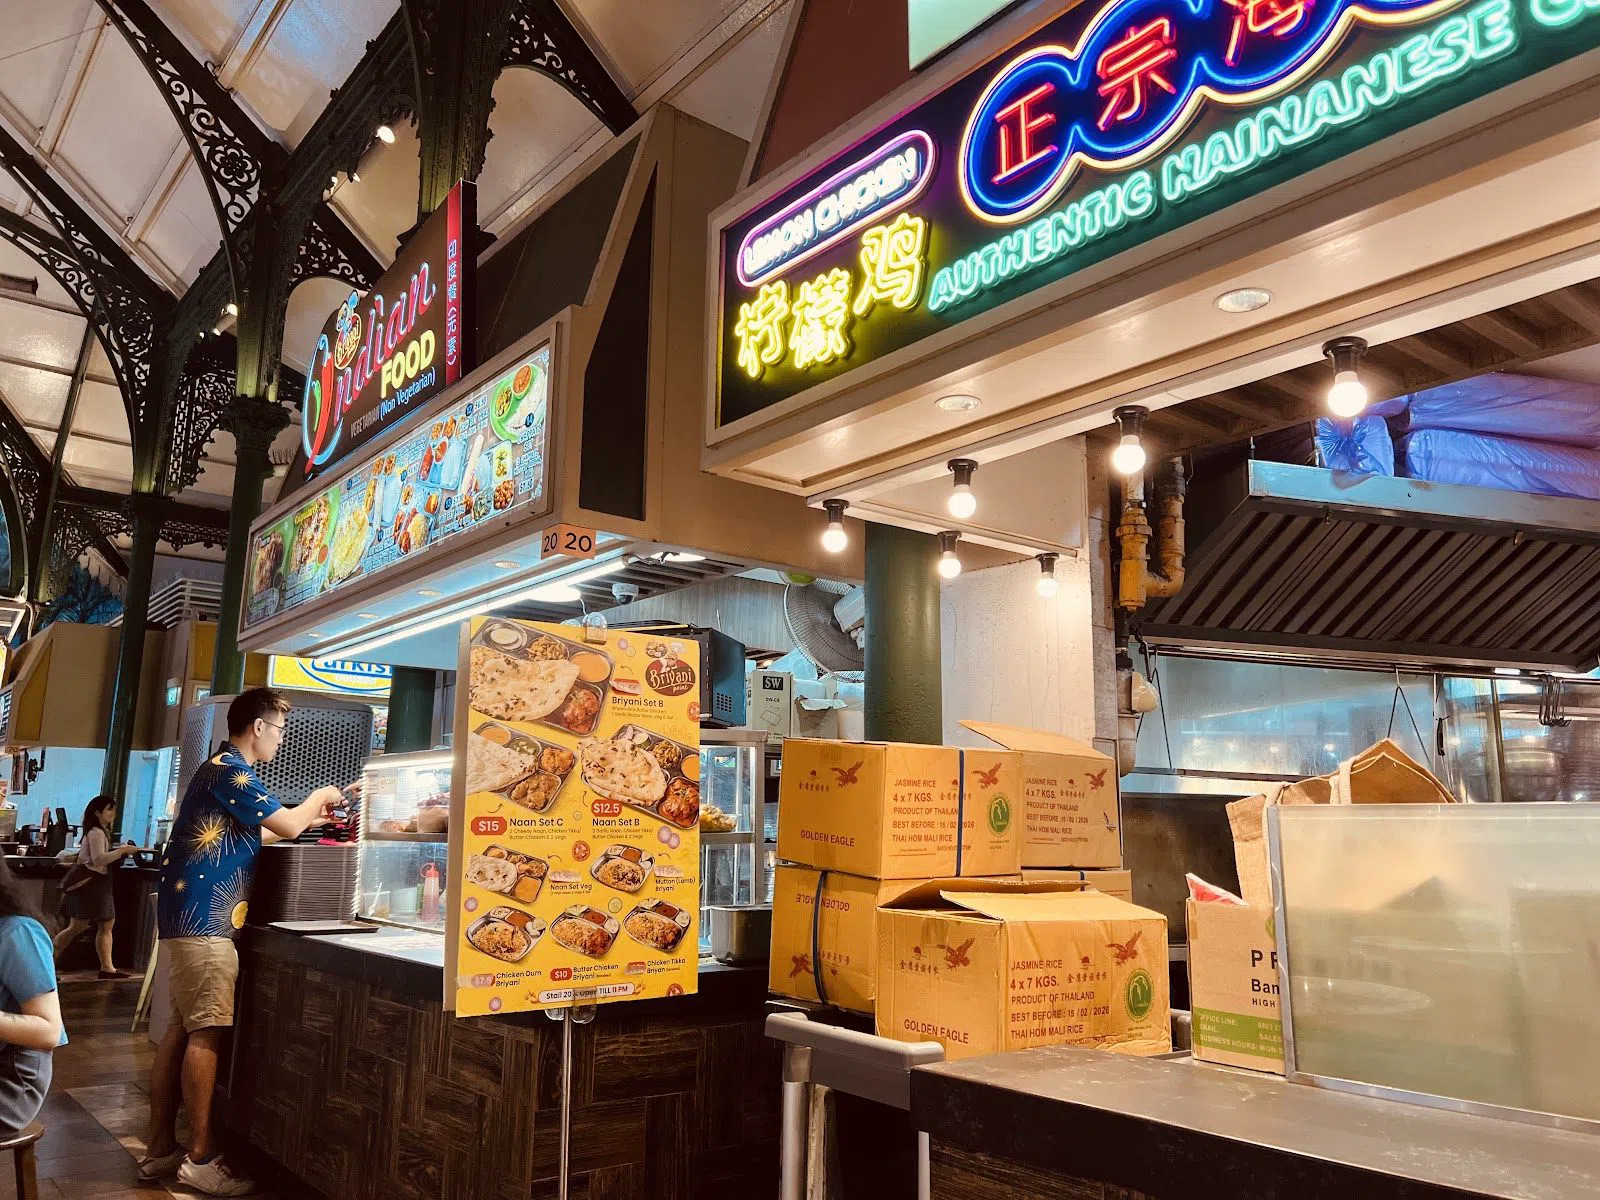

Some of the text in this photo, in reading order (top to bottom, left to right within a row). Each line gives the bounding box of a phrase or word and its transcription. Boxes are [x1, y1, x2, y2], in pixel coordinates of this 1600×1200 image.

[928, 4, 1515, 313] AUTHENTIC HAINANESE
[381, 329, 436, 399] FOOD
[380, 398, 396, 421] (Non
[396, 366, 436, 405] Vegetarian)
[543, 532, 558, 553] 20
[564, 532, 592, 553] 20
[650, 667, 692, 690] Briyani
[765, 677, 781, 689] SW
[611, 696, 664, 707] Briyani Set B
[894, 779, 936, 788] JASMINE RICE
[892, 793, 898, 802] 4
[900, 794, 906, 802] x
[907, 792, 913, 802] 7
[914, 792, 934, 802] KGS.
[1025, 788, 1030, 797] 4
[1036, 789, 1040, 797] 7
[1041, 789, 1056, 799] KGS.
[593, 803, 620, 814] $12.5
[893, 807, 959, 815] PRODUCT OF THAILAN
[1026, 801, 1049, 809] PRODUCT
[1057, 803, 1079, 812] THAILAND
[509, 818, 564, 827] Naan Set C
[592, 818, 640, 826] Naan Set B
[1026, 813, 1039, 821] BEST
[478, 819, 500, 832] $15
[892, 820, 910, 829] BEST
[911, 820, 935, 829] BEFORE
[961, 820, 975, 829] 026
[1039, 825, 1049, 833] HOM
[1061, 827, 1072, 835] RICE
[800, 829, 855, 847] GOLDEN EAGLE
[892, 834, 953, 842] THAI HOM MALI RICE
[581, 883, 593, 891] Veg
[655, 885, 675, 893] Briyani
[796, 893, 850, 911] GOLDEN AGLE
[1012, 959, 1063, 971] JASMINE RICE
[554, 971, 568, 979] $10
[572, 973, 595, 981] Briyani
[495, 979, 520, 987] Briyani
[1010, 978, 1016, 991] 4
[1018, 980, 1025, 989] x
[1026, 977, 1033, 989] 7
[1035, 975, 1059, 988] KGS.
[546, 991, 562, 1000] Stall
[563, 991, 572, 999] 20
[617, 985, 628, 993] PM
[1011, 991, 1095, 1005] PRODUCT OF THAILAND
[1252, 998, 1276, 1008] HIGH
[1011, 1006, 1110, 1023] BEST BEFORE 15 02 2026
[904, 1018, 969, 1044] GOLDEN EAGLE
[1011, 1024, 1084, 1040] THAI HOM MALI RICE
